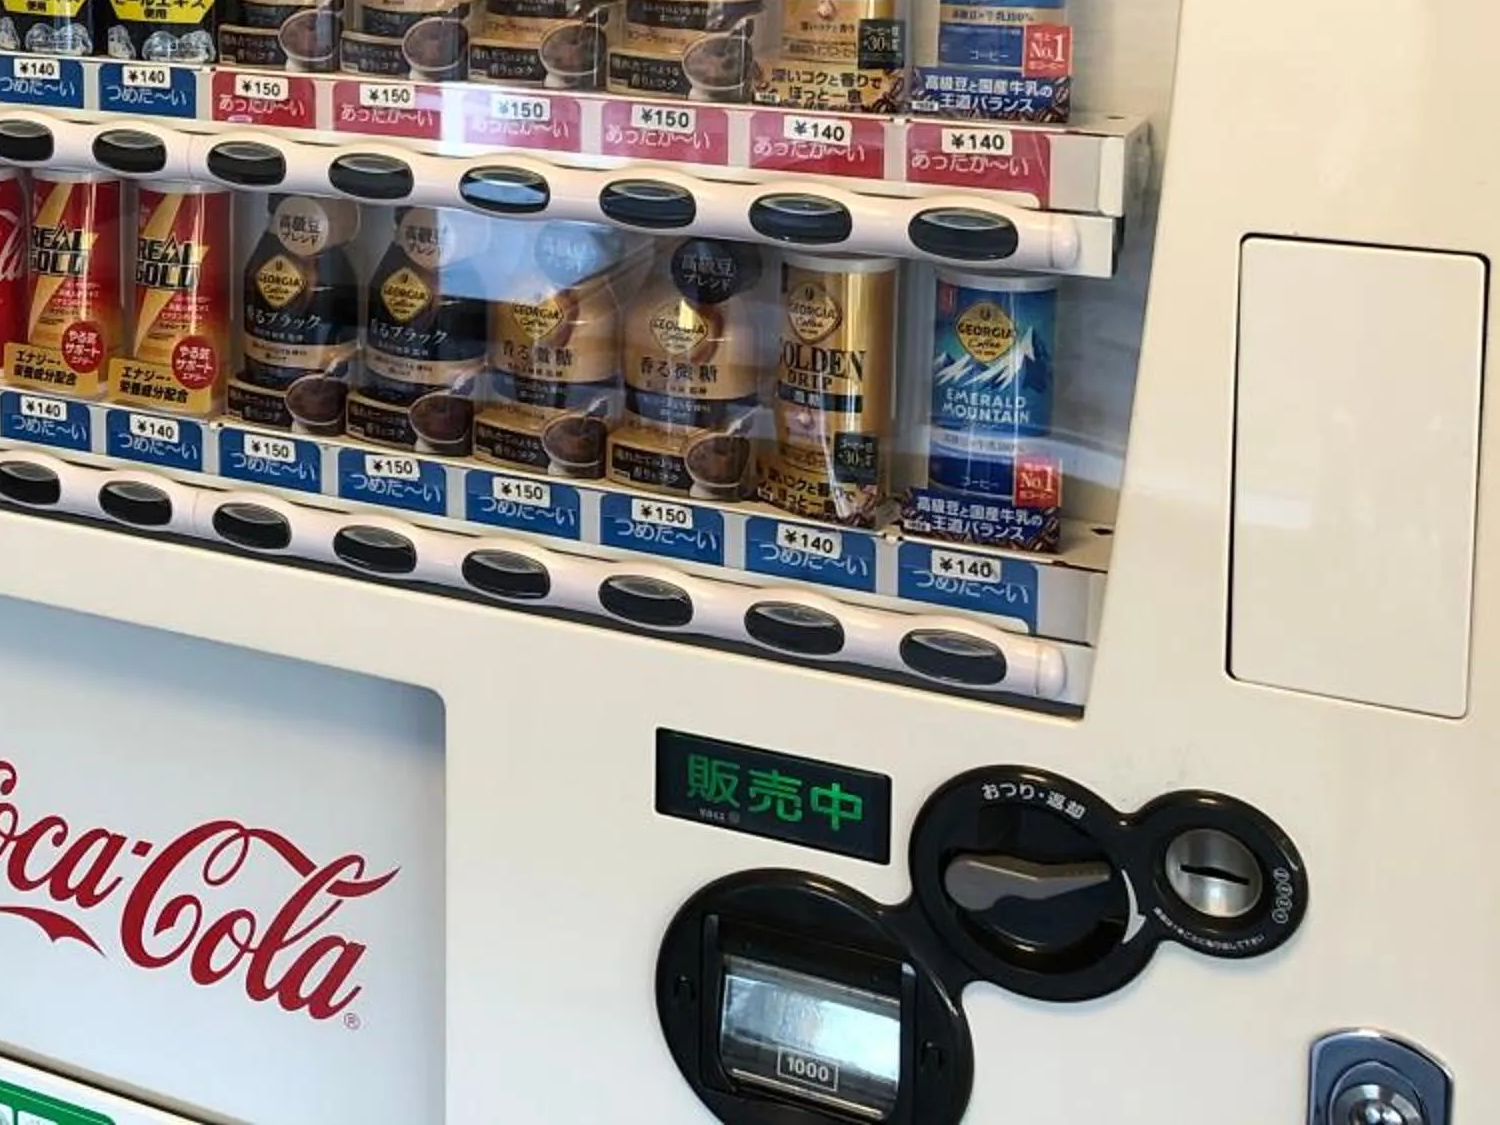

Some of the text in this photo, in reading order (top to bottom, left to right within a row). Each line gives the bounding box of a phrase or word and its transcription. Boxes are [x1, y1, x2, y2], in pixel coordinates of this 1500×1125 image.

[144, 8, 167, 20] 使用
[20, 63, 55, 77] ¥140
[128, 70, 166, 85] ¥140
[243, 81, 281, 97] ¥150
[368, 87, 411, 103] ¥150
[925, 77, 1053, 99] 高級豆と国産牛乳の
[499, 101, 543, 118] ¥150
[939, 94, 1034, 112] 王道バランス
[641, 109, 689, 129] ¥150
[794, 121, 845, 141] ¥140
[951, 133, 1005, 151] ¥140
[957, 322, 1014, 341] GEORGIA
[25, 399, 61, 416] ¥140
[947, 388, 1026, 408] EMERALD
[943, 403, 1030, 424] MOUNTAIN
[137, 421, 175, 437] ¥140
[252, 442, 290, 458] ¥150
[373, 458, 413, 474] ¥150
[501, 481, 544, 500] ¥150
[640, 504, 687, 524] ¥150
[916, 497, 1043, 526] 高級豆と国産牛乳の
[931, 517, 1025, 542] 王道バランス
[784, 531, 834, 554] ¥140
[939, 557, 992, 577] ¥140
[686, 753, 863, 832] 販売中
[980, 780, 1088, 821] おつり・返却
[785, 1053, 831, 1083] 1000
